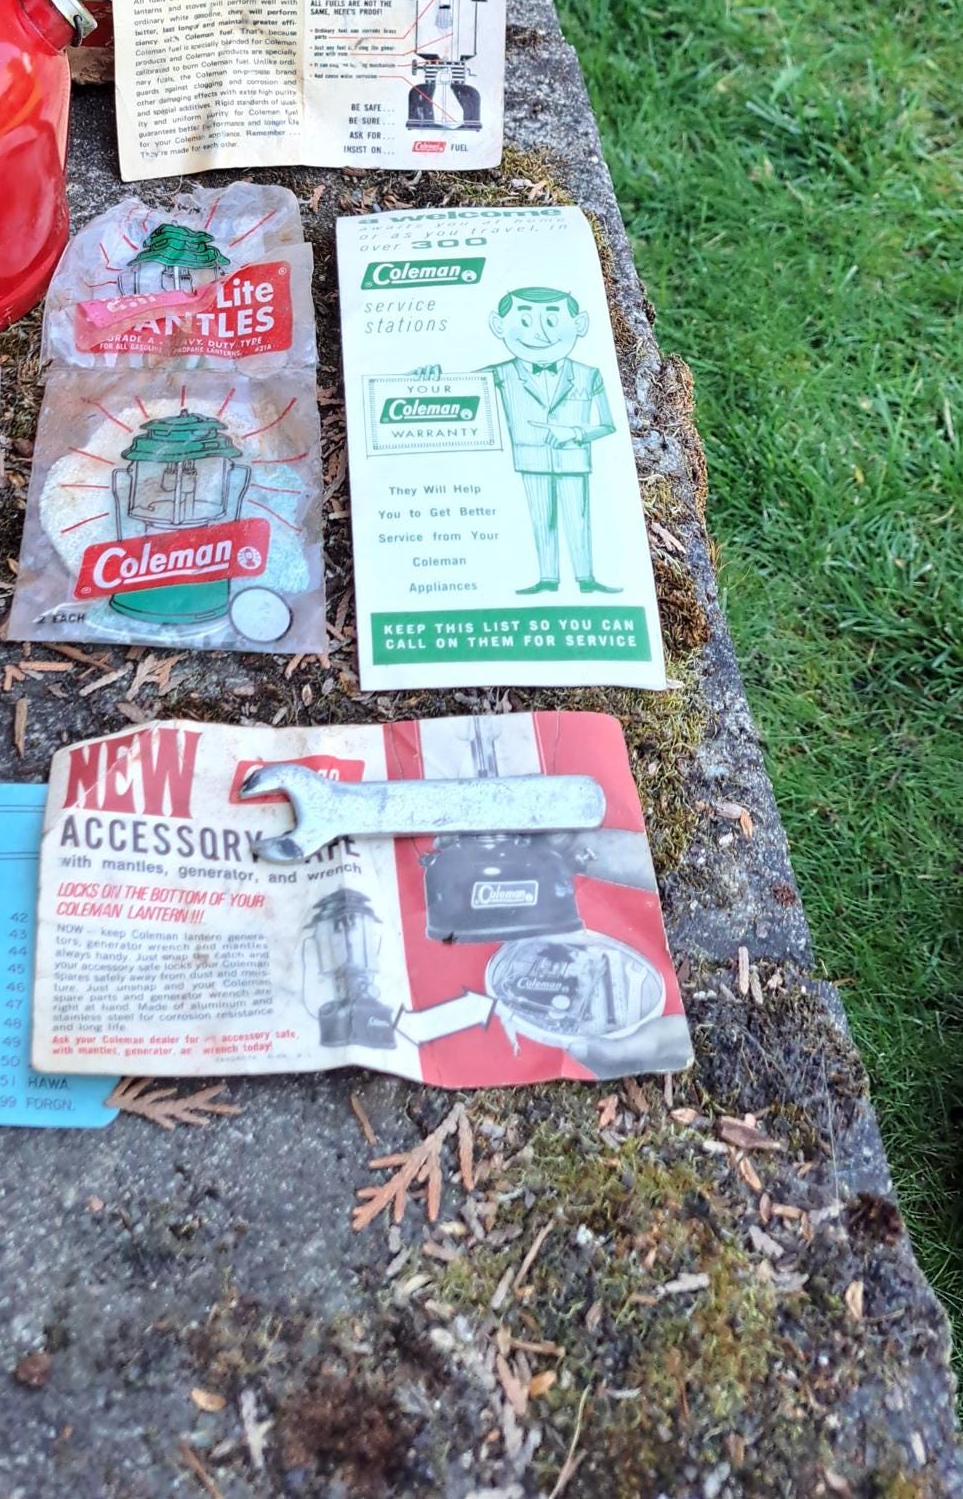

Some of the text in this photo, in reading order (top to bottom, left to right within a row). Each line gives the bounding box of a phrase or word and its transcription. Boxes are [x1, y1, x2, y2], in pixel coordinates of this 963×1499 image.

[310, 0, 392, 7] ALL FUELS ARE NOT THE
[310, 8, 330, 16] SAME,
[359, 8, 383, 16] PROOF!
[351, 103, 360, 111] BE
[348, 117, 358, 125] BE
[349, 131, 364, 139] ASK
[343, 146, 367, 154] INSIST
[451, 144, 468, 152] FUEL
[389, 209, 562, 222] welcome
[424, 229, 459, 238] you
[360, 237, 487, 252] over 300
[372, 263, 461, 285] Coleman
[216, 278, 274, 308] Lite
[364, 298, 436, 314] service
[133, 306, 275, 338] ANTLES
[364, 316, 448, 335] stations
[208, 340, 236, 349] DUTY
[240, 337, 262, 347] TYPE
[407, 385, 451, 393] YOUR
[388, 399, 461, 420] Coleman
[391, 428, 478, 438] WARRANTY
[388, 484, 481, 497] They Will Help
[378, 506, 496, 520] You to Get Better
[378, 530, 499, 543] Service from Your
[93, 540, 232, 588] Coleman
[412, 556, 467, 567] Coleman
[409, 582, 478, 594] Appliances
[52, 612, 85, 624] EACH
[384, 619, 635, 635] KEEP THIS LIST SO YOU CAN
[386, 634, 637, 650] CALL ON THEM FOR SERVICE
[63, 727, 203, 819] NEW
[59, 815, 263, 864] ACCESSORY
[59, 855, 363, 884] with mantles, generator, and wrench
[57, 882, 266, 909] LOCKS ON THE BOTTOM OF YOUR
[478, 884, 526, 904] Coleman
[56, 901, 122, 918] COLEMAN
[10, 912, 29, 923] 42
[517, 977, 562, 989] Coleman
[52, 1035, 69, 1044] Ask
[76, 1036, 96, 1045] your
[102, 1035, 144, 1044] Coleman
[149, 1035, 179, 1044] dealer
[185, 1035, 199, 1044] for
[221, 1031, 270, 1043] accessory
